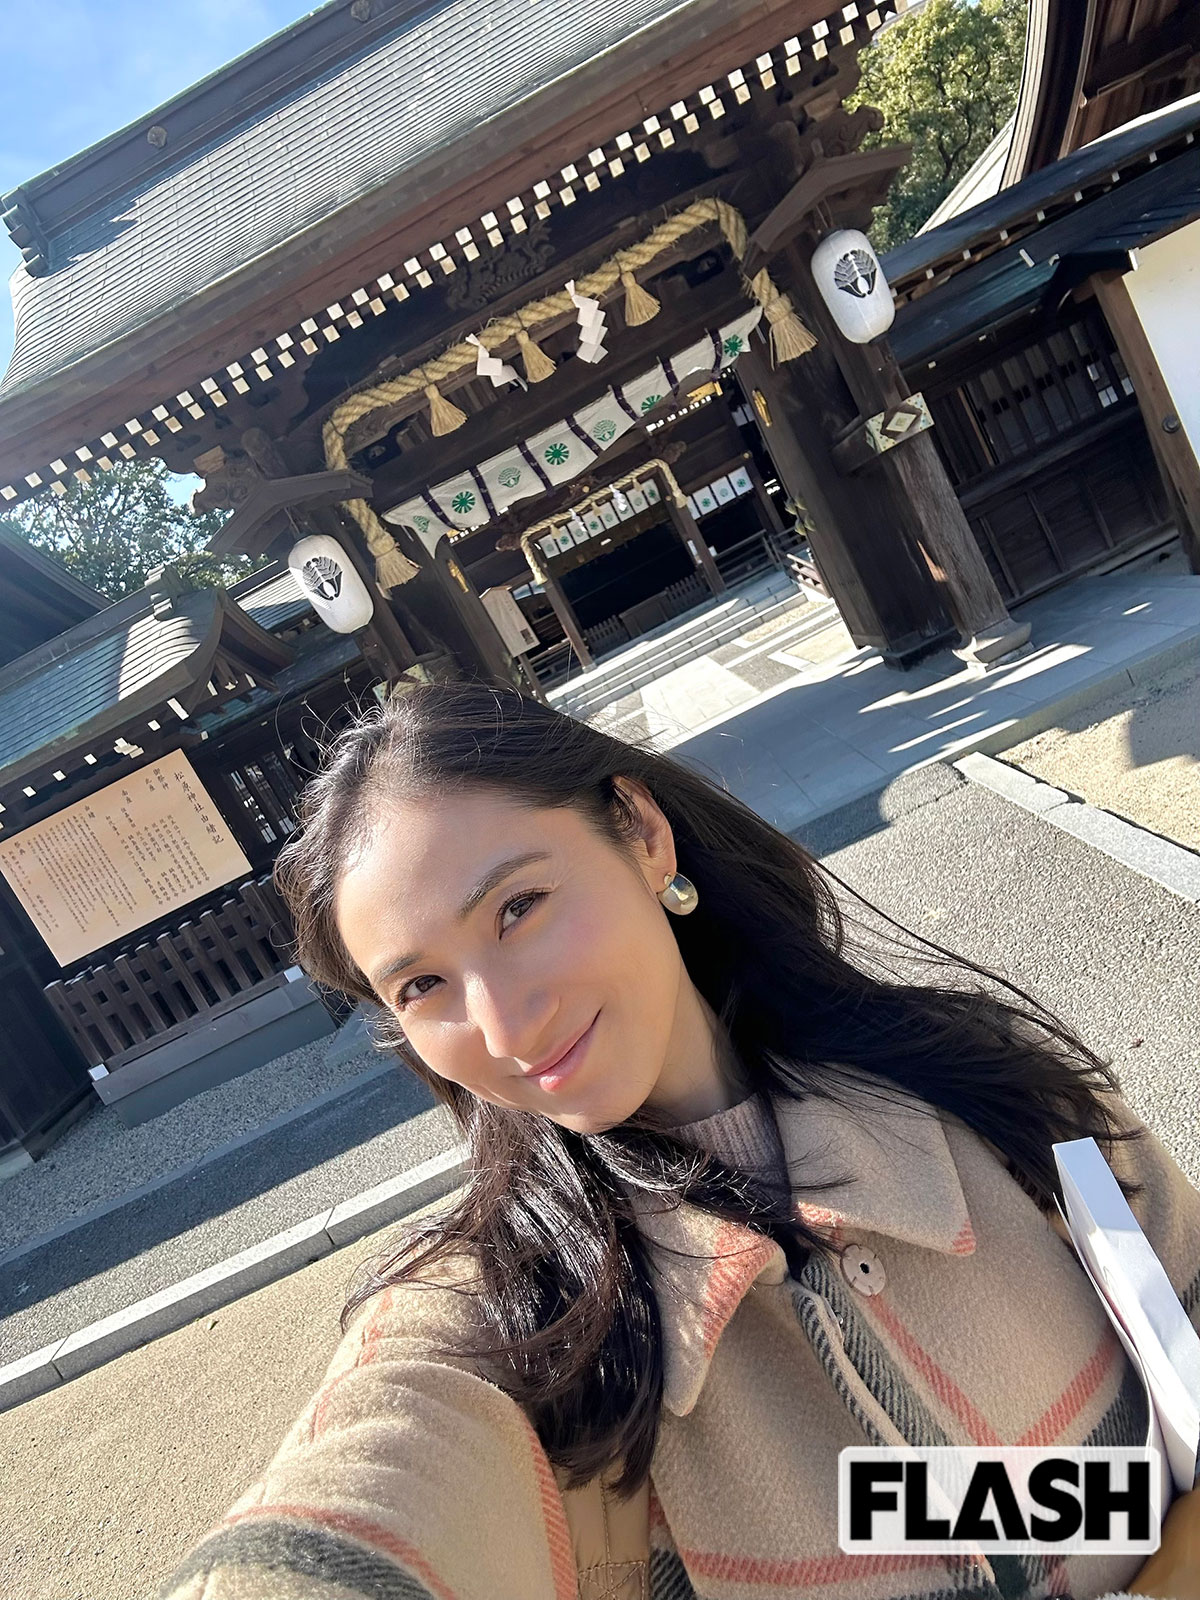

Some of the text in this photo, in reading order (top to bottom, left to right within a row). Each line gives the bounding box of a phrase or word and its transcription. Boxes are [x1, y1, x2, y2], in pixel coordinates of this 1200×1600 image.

[173, 771, 223, 844] 松原神社由緒記
